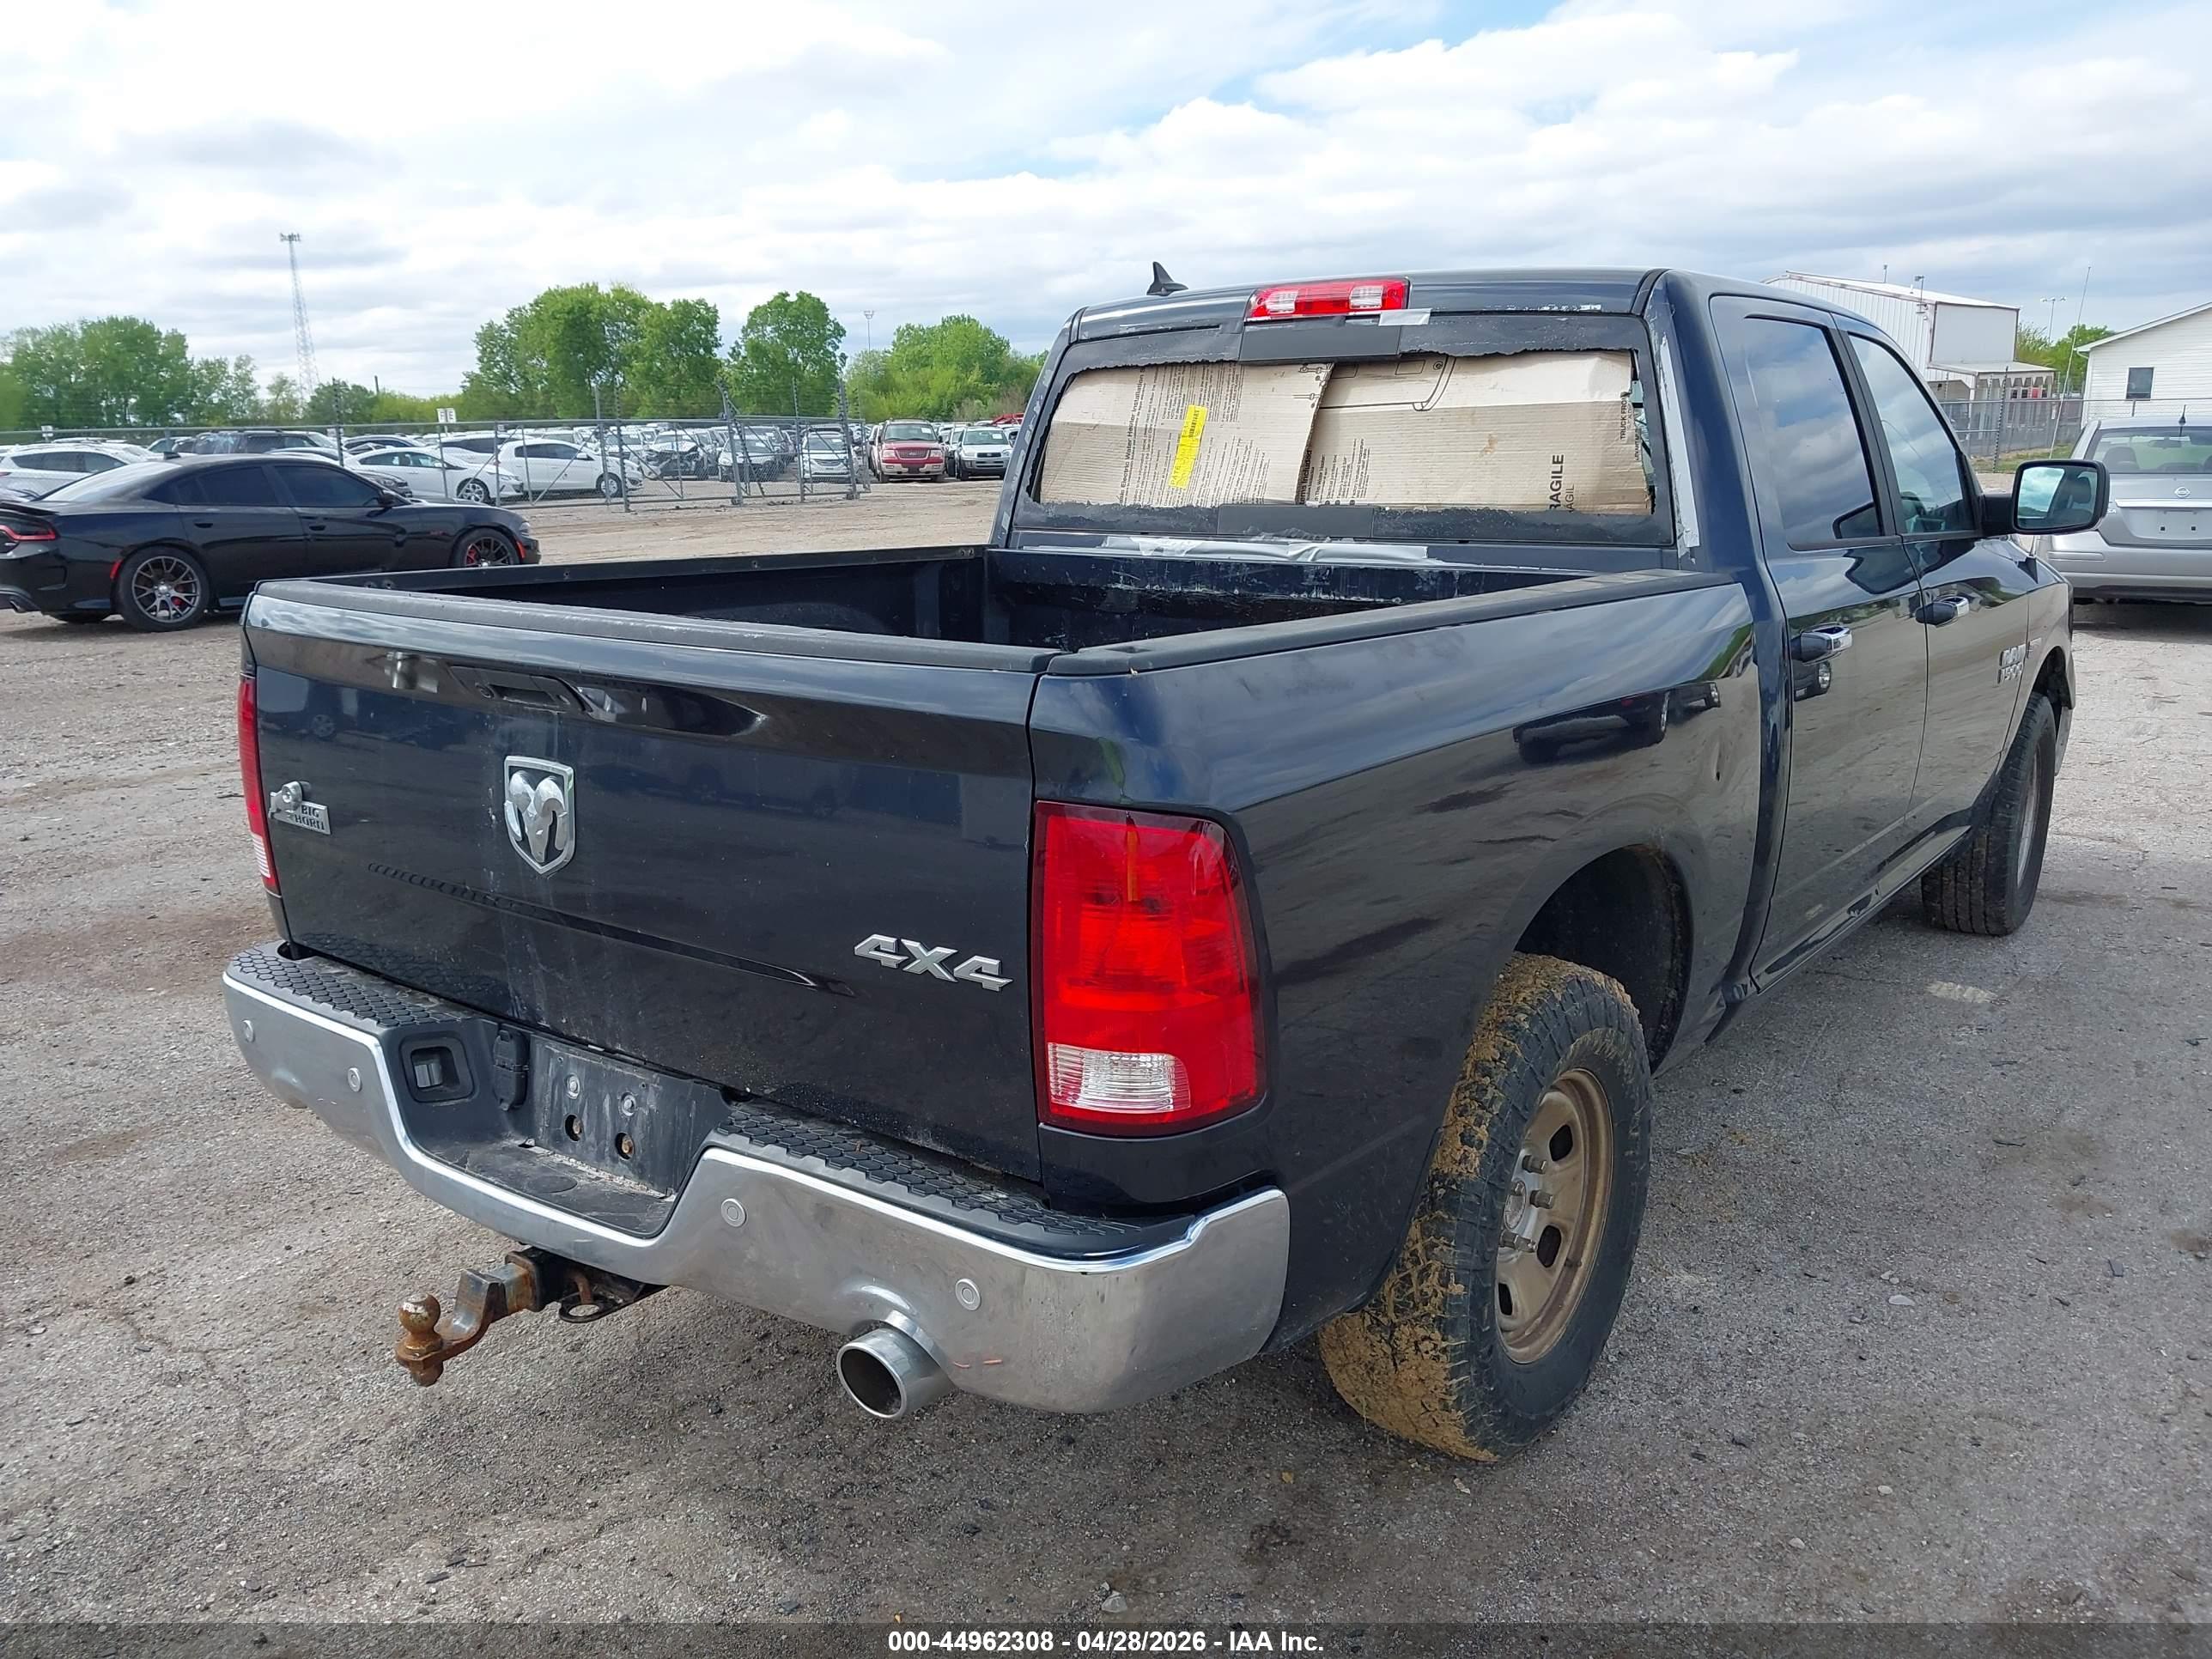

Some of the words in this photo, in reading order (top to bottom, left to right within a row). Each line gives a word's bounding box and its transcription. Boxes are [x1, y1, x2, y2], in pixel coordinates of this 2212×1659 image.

[1131, 374, 1145, 412] Installation
[1124, 438, 1133, 460] Water
[1120, 461, 1130, 488] Electric
[1301, 450, 1312, 483] Included
[294, 813, 325, 831] HORN
[301, 805, 319, 818] BIG
